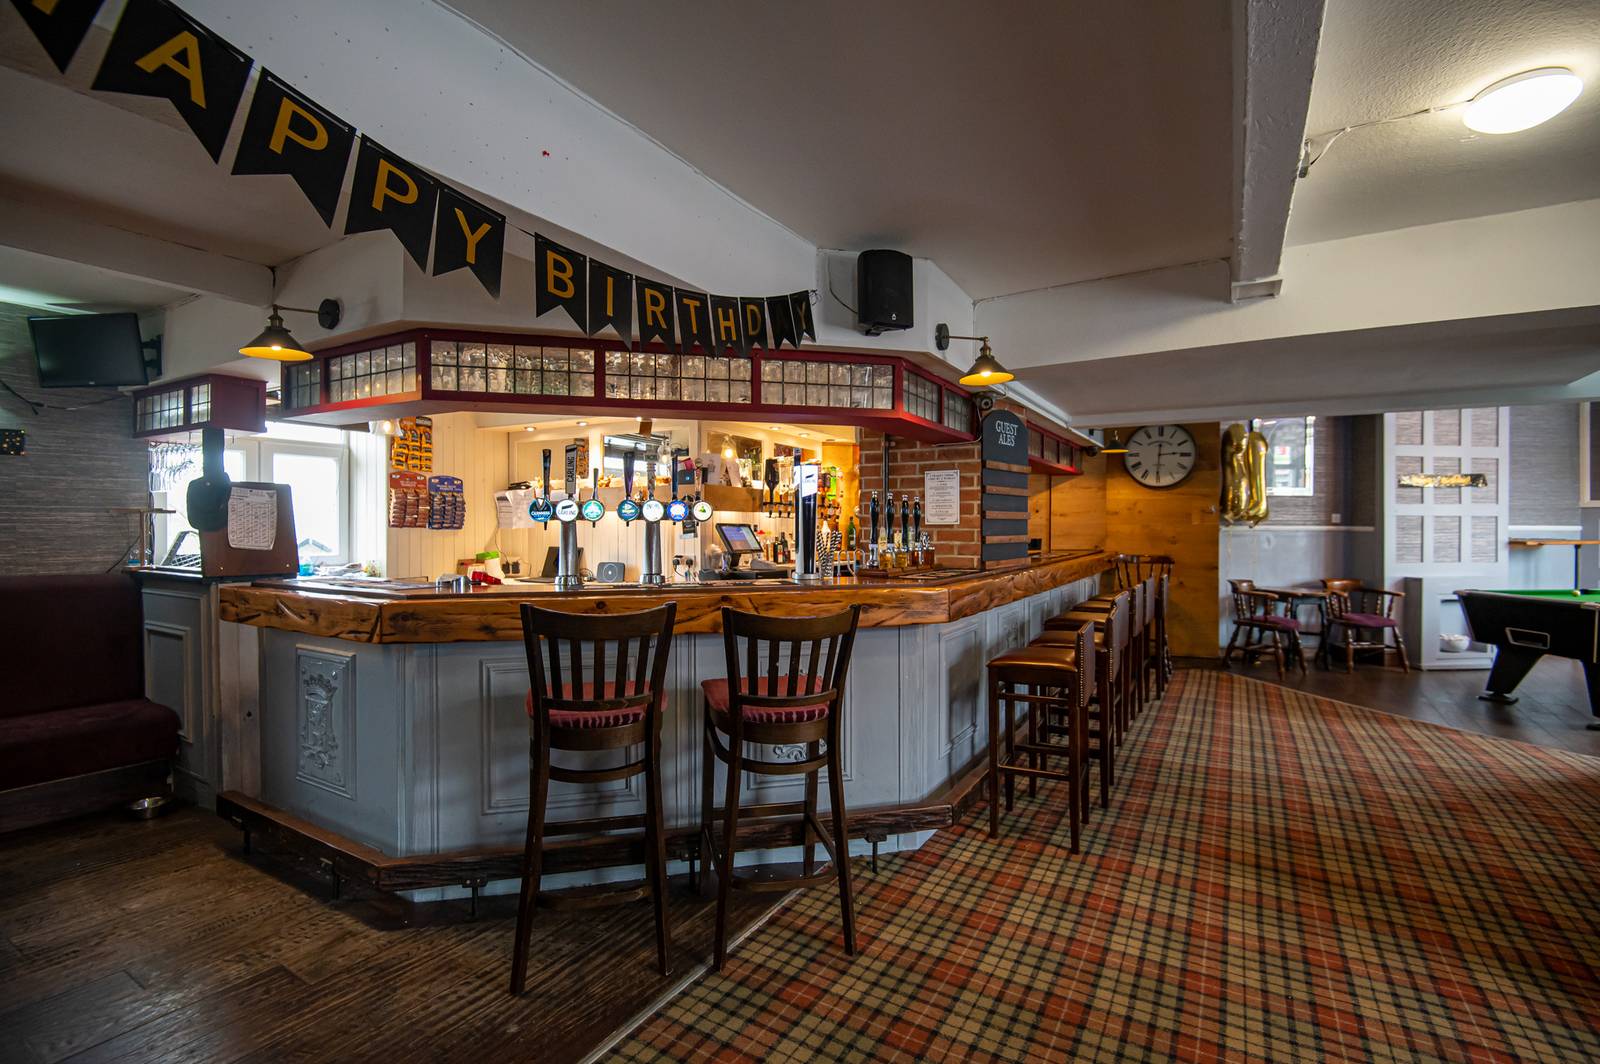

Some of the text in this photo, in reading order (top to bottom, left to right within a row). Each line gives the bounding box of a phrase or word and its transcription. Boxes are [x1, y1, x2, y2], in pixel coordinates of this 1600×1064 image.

[32, 0, 491, 264] APPY
[546, 249, 807, 341] BIRTHDY
[995, 420, 1018, 436] GUEST
[998, 433, 1016, 447] ALES
[567, 456, 575, 482] CARLING
